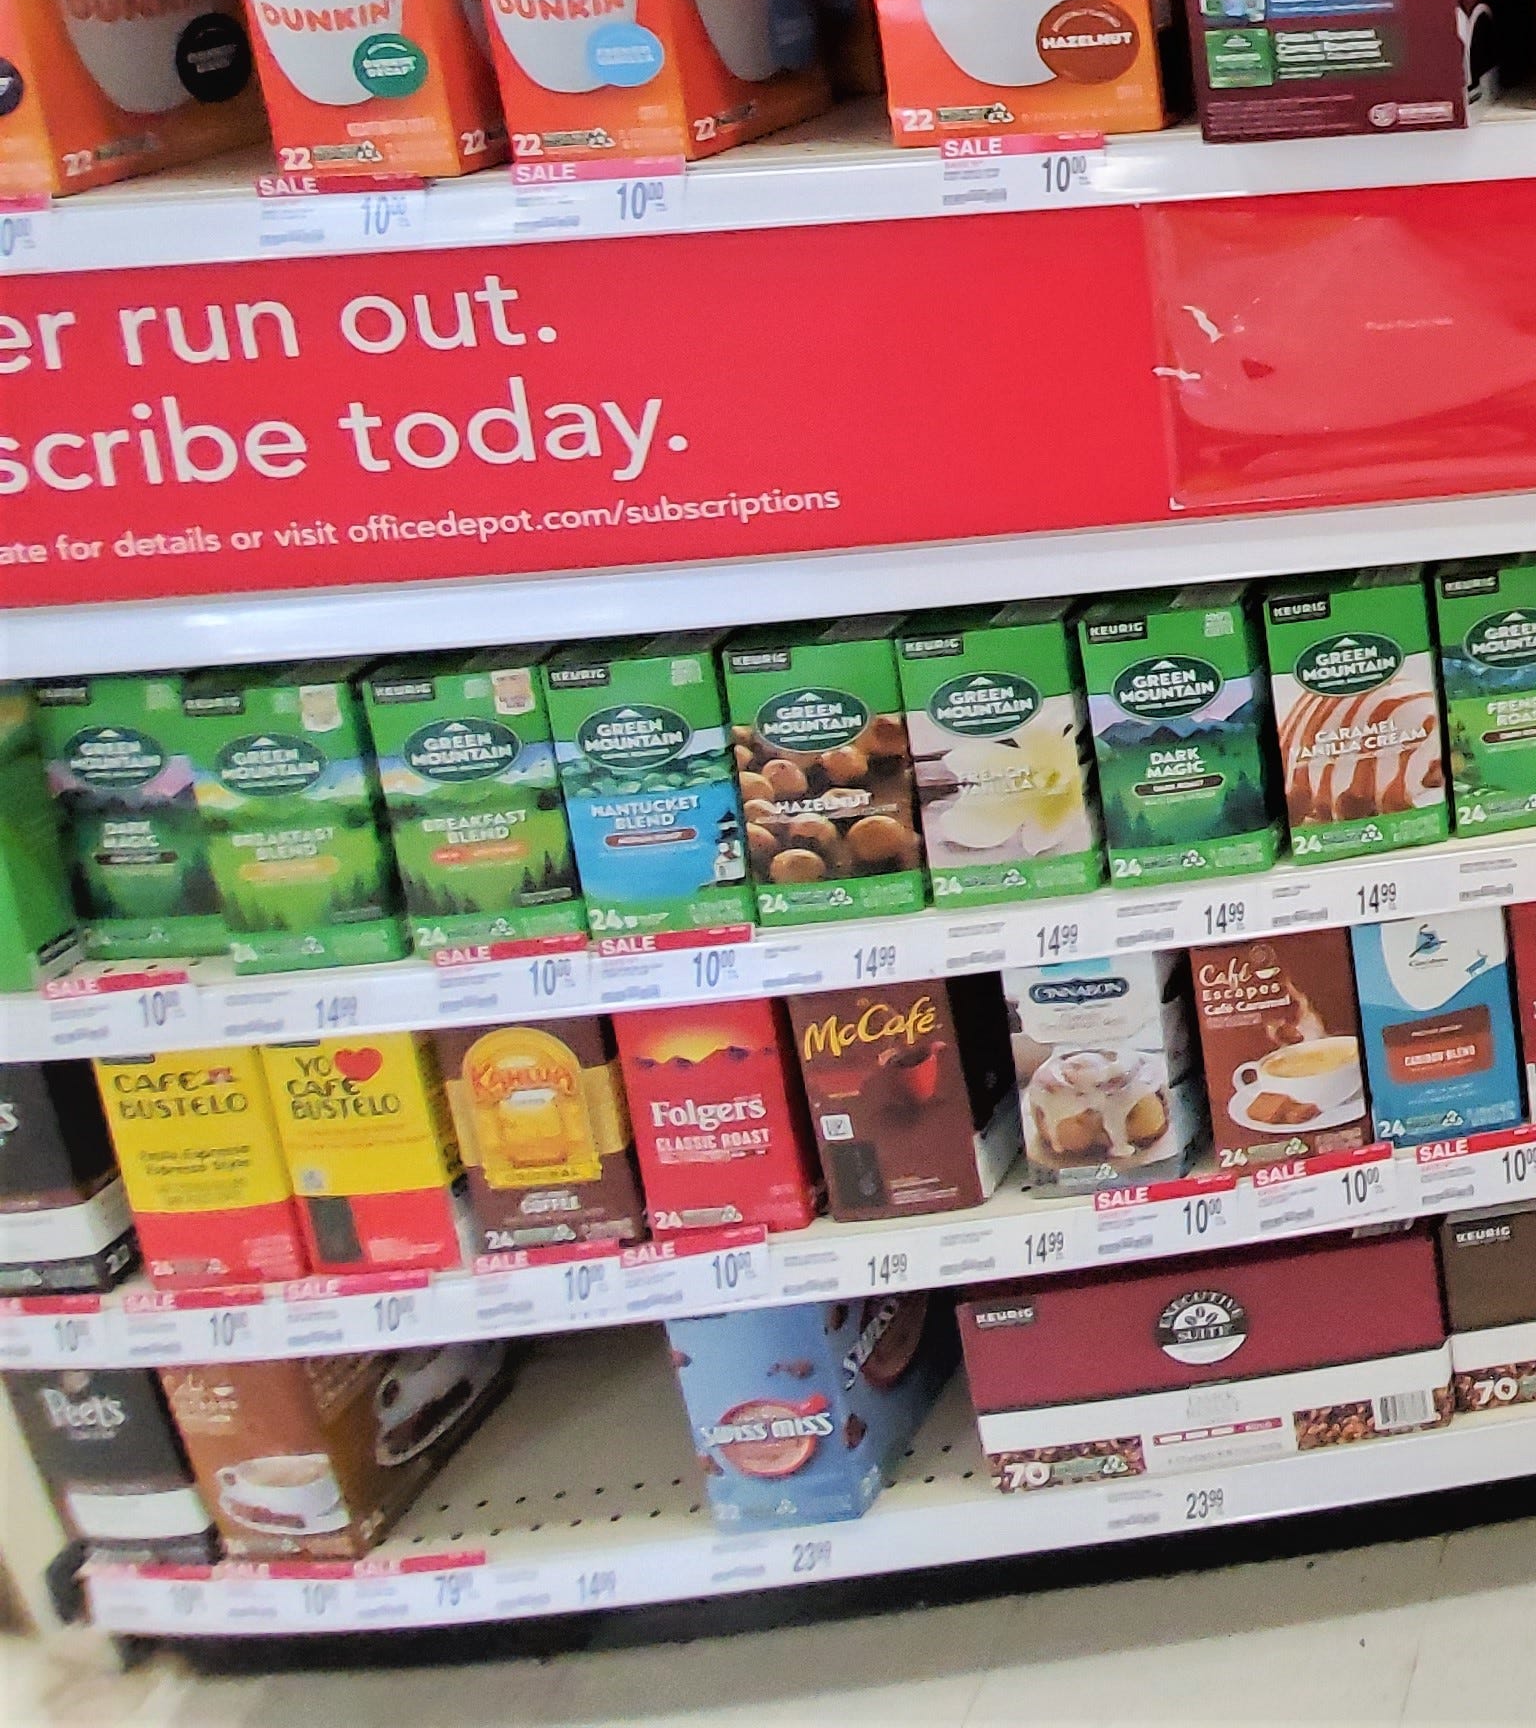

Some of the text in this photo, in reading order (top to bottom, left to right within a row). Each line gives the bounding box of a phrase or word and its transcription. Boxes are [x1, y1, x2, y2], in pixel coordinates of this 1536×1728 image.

[902, 109, 935, 131] 22
[513, 134, 543, 156] 22
[279, 147, 312, 170] 22
[119, 297, 300, 368] run
[339, 273, 559, 355] out.
[0, 375, 689, 497] scribe today.
[56, 530, 106, 563] for
[112, 526, 220, 560] details
[231, 526, 263, 550] or
[274, 518, 337, 547] visit
[348, 486, 841, 545] officedepot.com/subscriptions
[1090, 621, 1144, 636] KEURIG
[1315, 646, 1378, 666] GREEN
[1131, 670, 1196, 688] GREEN
[1302, 656, 1396, 681] MOUNTAIN
[949, 686, 1014, 705] GREEN
[1119, 681, 1215, 704] MOUNTAIN
[775, 701, 842, 722] GREEN
[936, 697, 1033, 720] MOUNTAIN
[596, 717, 663, 738] GREEN
[762, 712, 863, 735] MOUNTAIN
[423, 732, 492, 752] GREEN
[584, 729, 684, 753] MOUNTAIN
[1149, 748, 1201, 765] DARK
[1146, 760, 1206, 778] MAGIC
[590, 793, 700, 818] NANTUCKET
[773, 791, 872, 814] HAZELNUT
[614, 811, 676, 829] BLEND
[1458, 805, 1487, 824] 24
[1295, 835, 1323, 854] 24
[1114, 859, 1142, 877] 24
[758, 893, 789, 914] 24
[803, 995, 939, 1061] McCafé
[652, 1096, 767, 1131] Folgers
[1420, 1138, 1469, 1161] SALE
[1257, 1163, 1307, 1185] SALE
[1097, 1188, 1149, 1209] SALE
[1473, 1376, 1519, 1405] 70
[1005, 1463, 1054, 1488] 70
